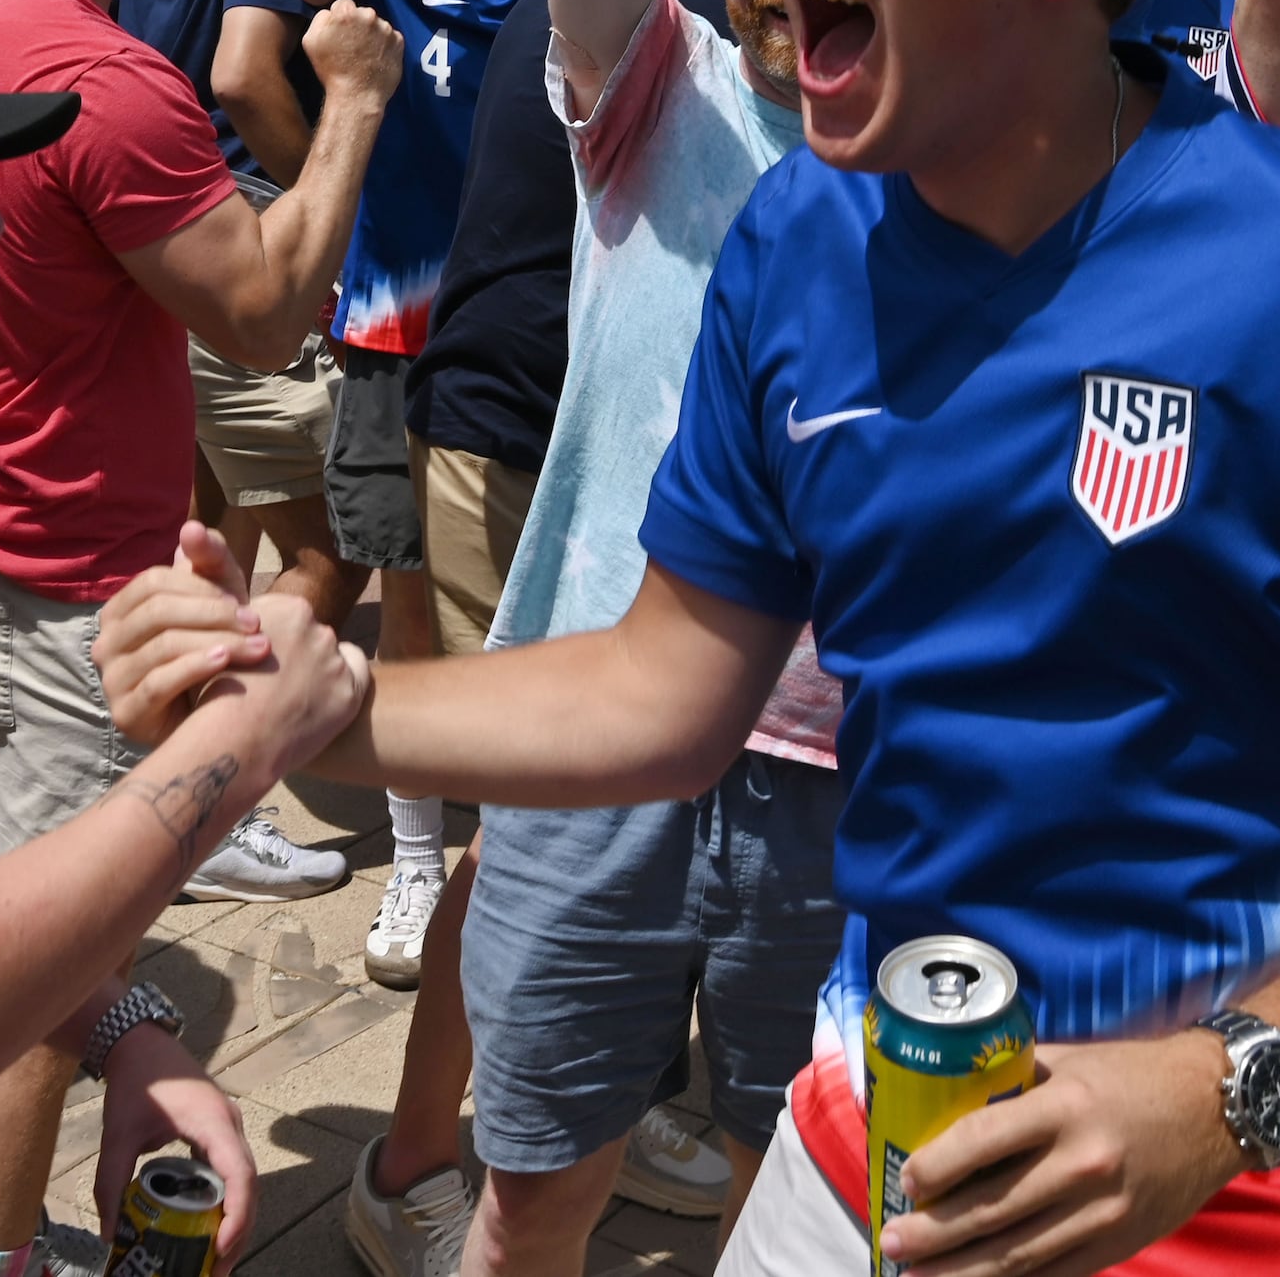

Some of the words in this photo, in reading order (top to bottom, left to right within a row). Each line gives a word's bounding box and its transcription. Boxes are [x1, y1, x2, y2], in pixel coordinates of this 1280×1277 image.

[420, 28, 451, 98] 4
[1192, 28, 1227, 49] USA
[1092, 379, 1187, 446] USA
